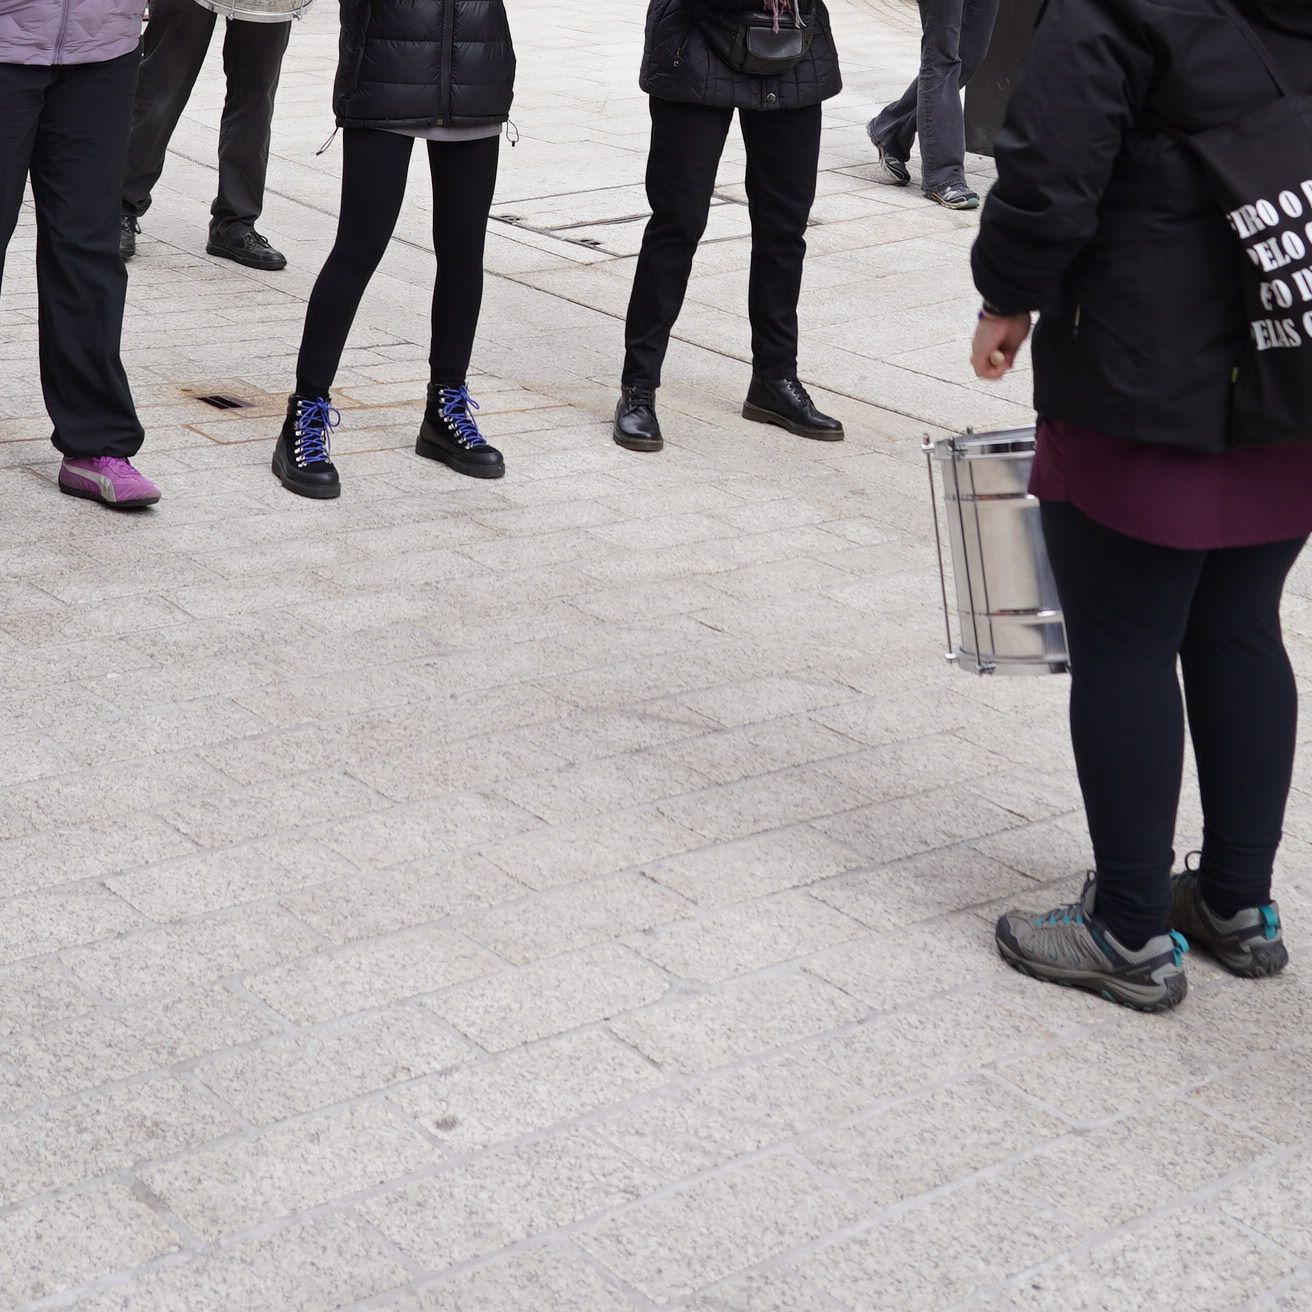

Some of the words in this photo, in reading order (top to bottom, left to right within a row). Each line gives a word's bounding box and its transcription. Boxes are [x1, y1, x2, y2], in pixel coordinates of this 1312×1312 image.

[1278, 190, 1304, 219] O
[1271, 278, 1293, 308] O
[1249, 318, 1302, 351] ELAS
